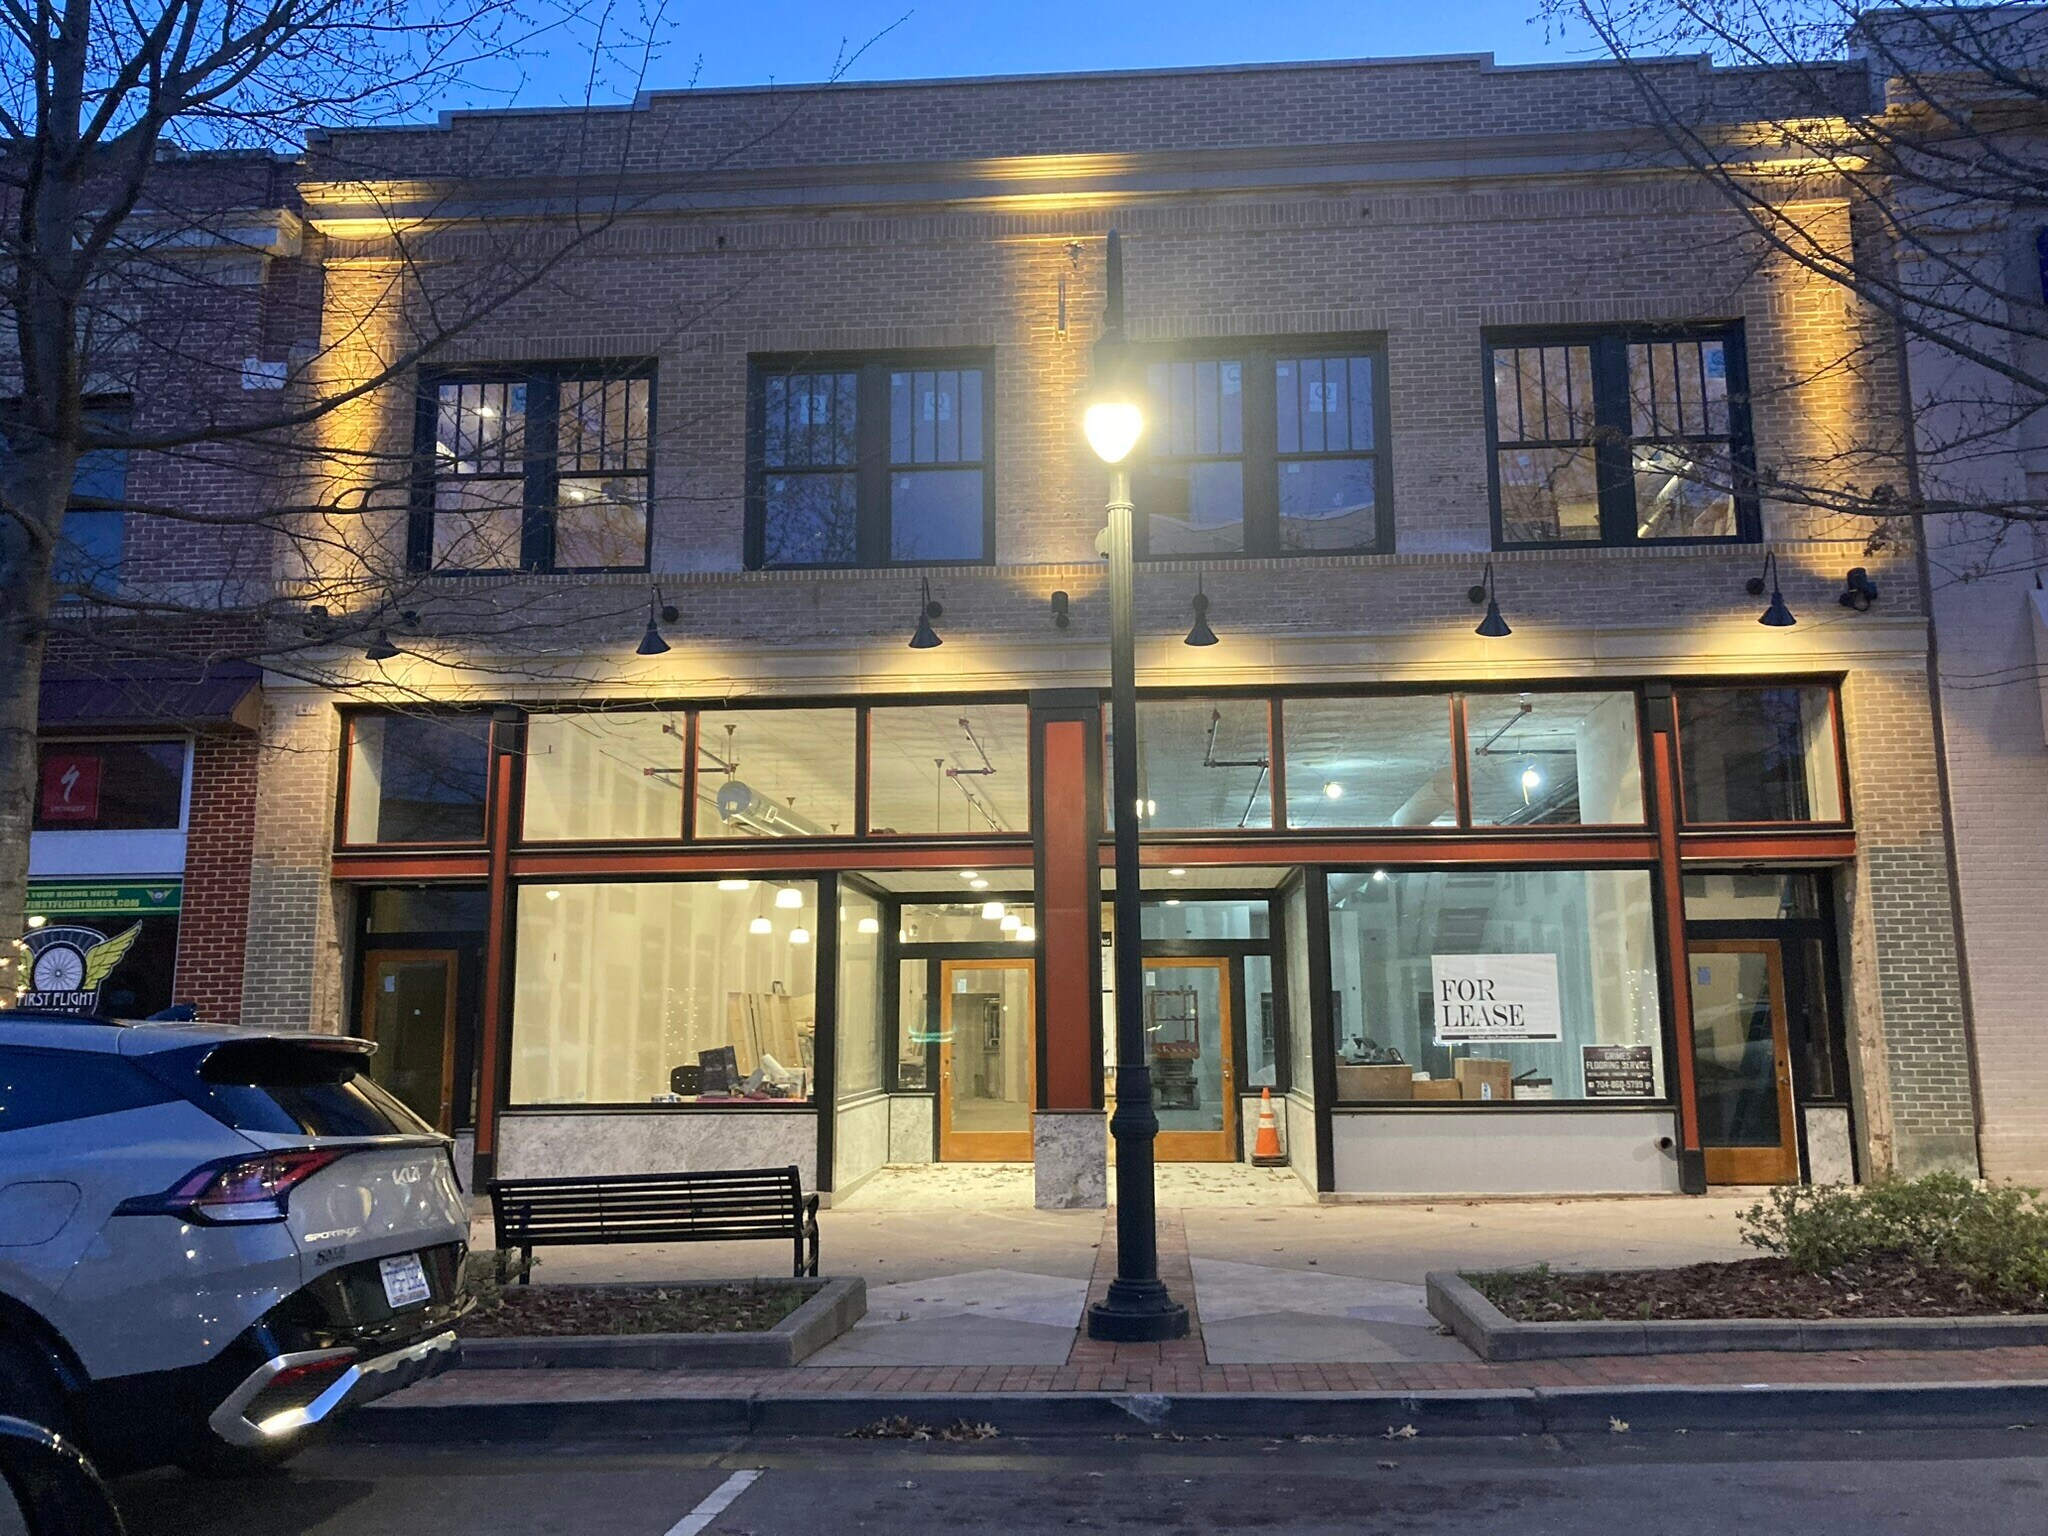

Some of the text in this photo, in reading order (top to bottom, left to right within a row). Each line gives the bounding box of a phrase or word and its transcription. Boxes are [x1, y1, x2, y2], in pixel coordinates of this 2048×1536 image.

[17, 992, 95, 1007] FIRST FLIGHT
[1440, 979, 1496, 1002] FOR
[1442, 1004, 1525, 1028] LEASE
[1586, 1061, 1651, 1070] FLOORING SERVICE
